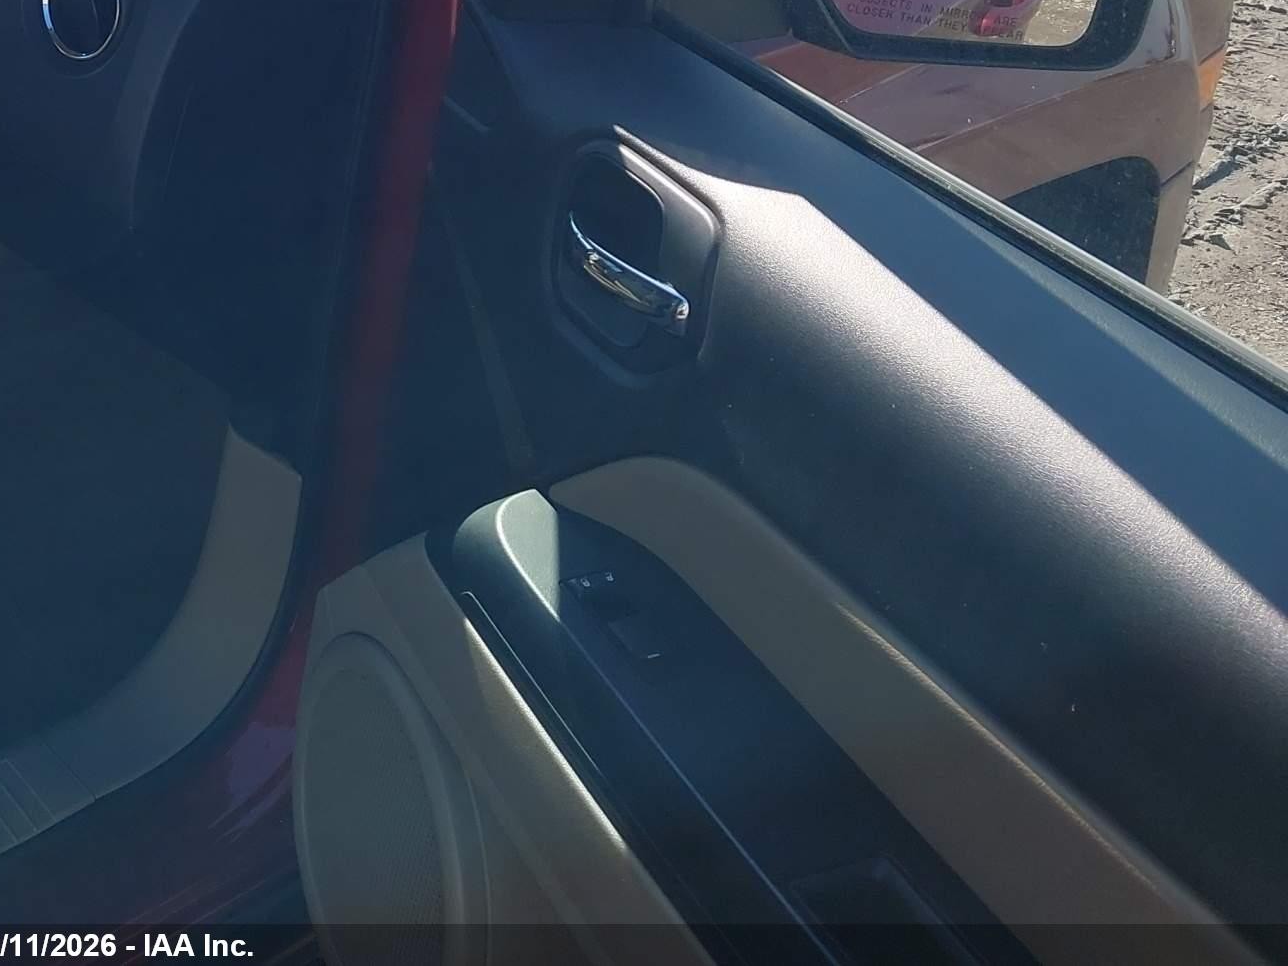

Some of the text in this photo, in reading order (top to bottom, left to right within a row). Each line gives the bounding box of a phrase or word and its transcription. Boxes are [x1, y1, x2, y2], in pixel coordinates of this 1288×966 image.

[847, 2, 894, 19] CLOSER
[900, 12, 932, 27] THAN
[938, 17, 967, 32] THEY
[921, 3, 934, 14] IN
[939, 6, 983, 22] MIRRO
[993, 15, 1019, 28] ARE
